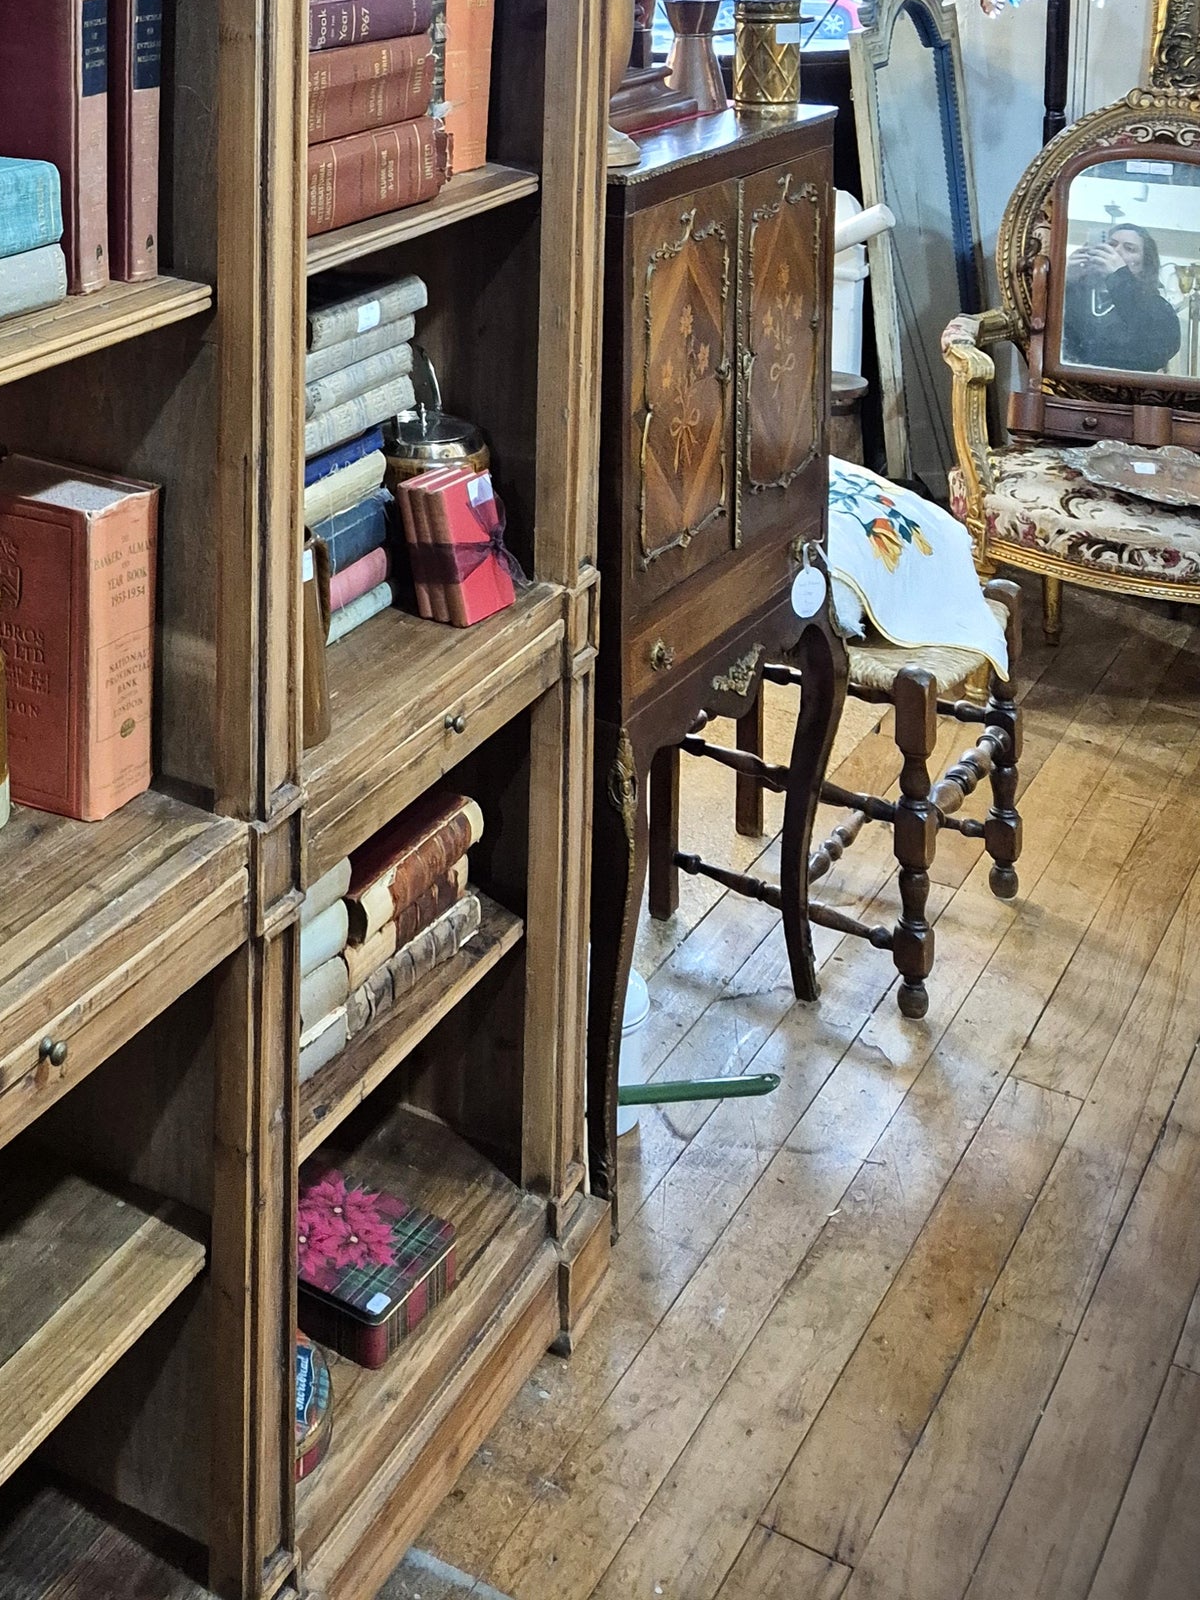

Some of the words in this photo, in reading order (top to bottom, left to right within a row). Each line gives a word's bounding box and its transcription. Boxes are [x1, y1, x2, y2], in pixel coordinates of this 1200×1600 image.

[318, 8, 327, 45] Book
[339, 8, 348, 41] Year
[361, 7, 370, 36] 1967
[424, 144, 434, 179] UNITED
[317, 162, 326, 224] INTERNATIONAL
[325, 162, 333, 221] ENCYCLOPEDIA
[108, 573, 124, 591] YEAR
[126, 566, 147, 583] BOOK
[117, 678, 138, 695] BANK
